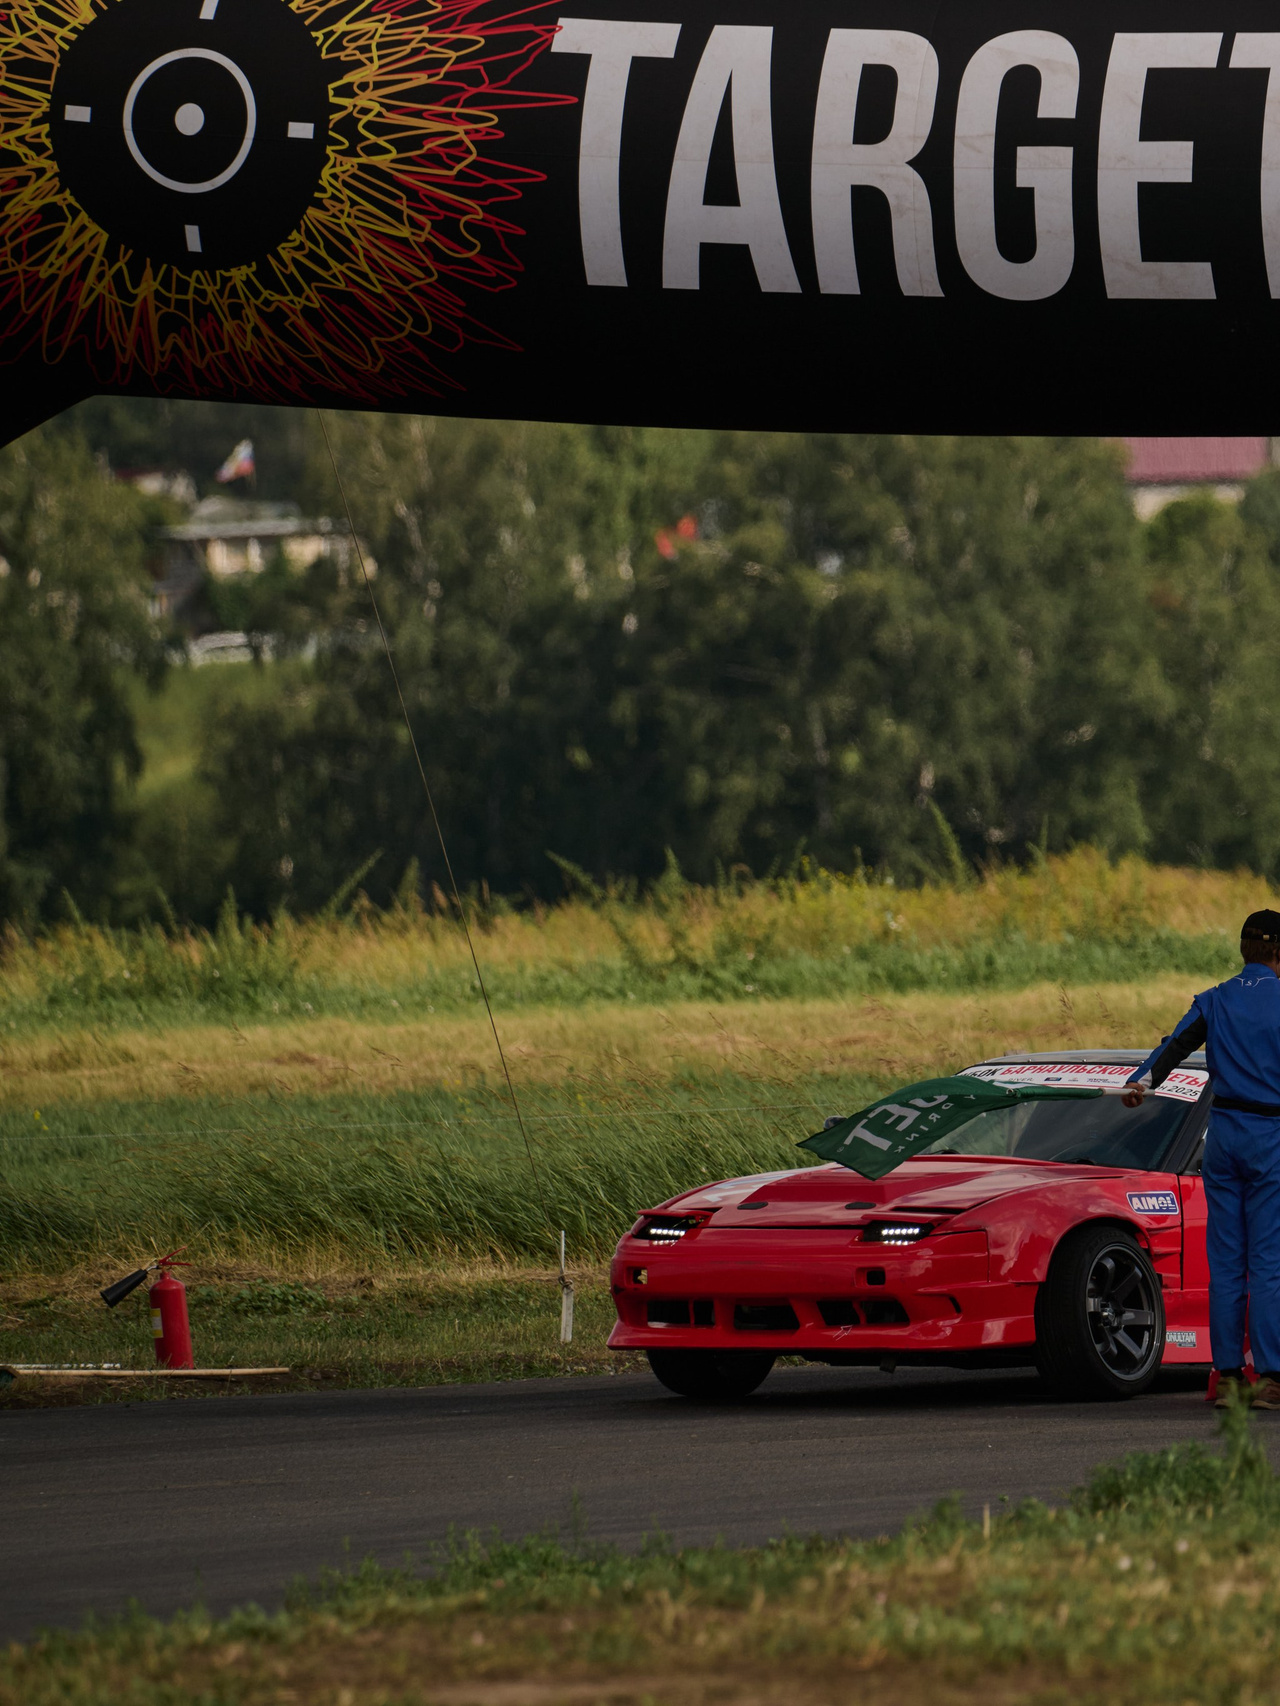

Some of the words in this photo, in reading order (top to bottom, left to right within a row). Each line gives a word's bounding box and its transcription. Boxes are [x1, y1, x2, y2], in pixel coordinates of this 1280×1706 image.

[1000, 1065, 1136, 1076] БАРНАУЛЬСКОЙ
[1168, 1085, 1200, 1097] 2025
[1131, 1196, 1176, 1210] AIMOL
